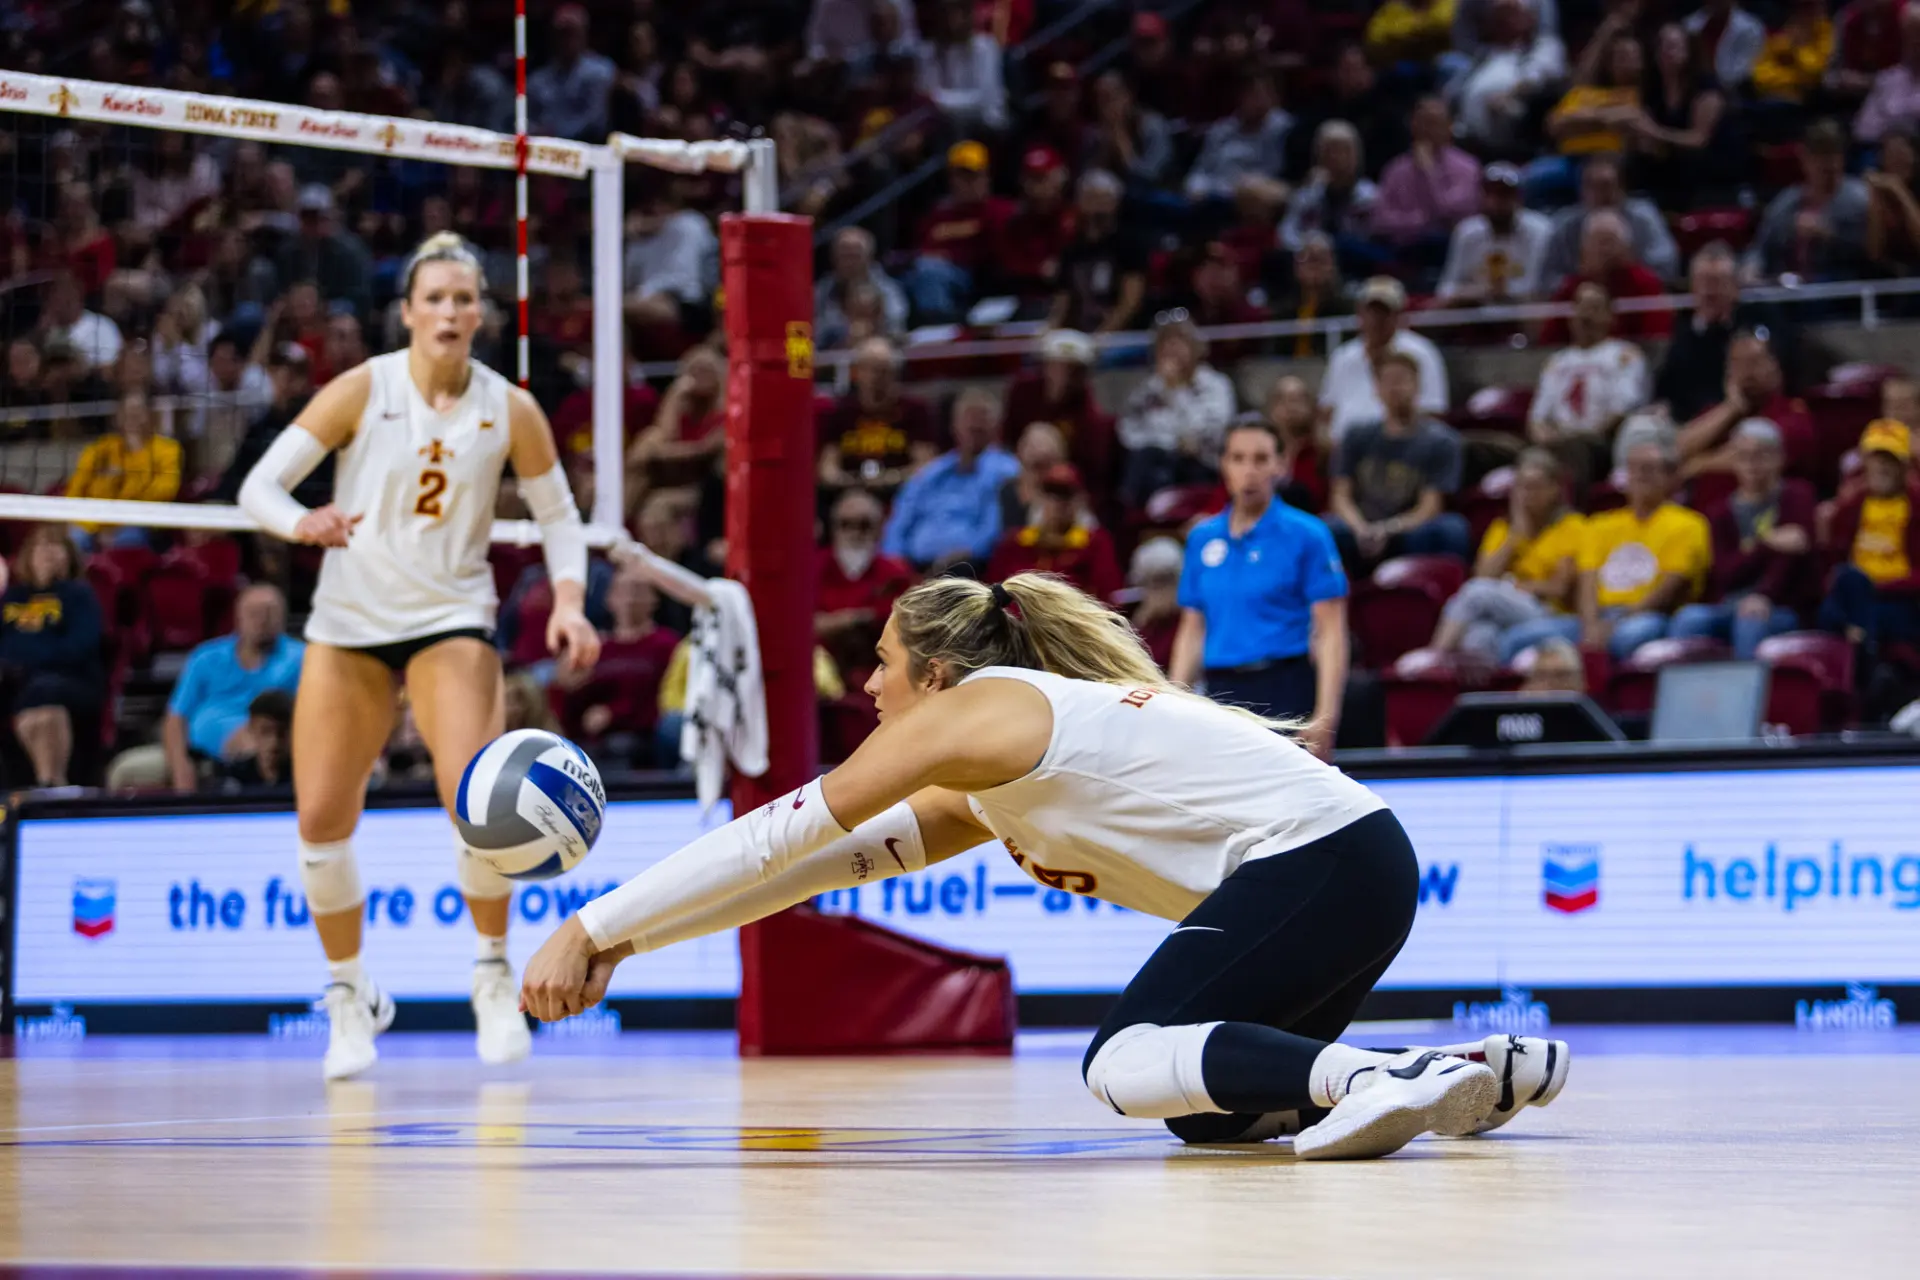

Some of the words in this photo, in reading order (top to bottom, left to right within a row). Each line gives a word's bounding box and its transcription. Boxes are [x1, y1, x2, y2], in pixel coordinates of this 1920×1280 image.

[184, 100, 225, 125] IOWA
[229, 107, 280, 129] STATE
[414, 468, 447, 519] 2
[562, 759, 607, 810] molte
[1683, 840, 1920, 912] helping
[169, 879, 247, 930] the
[265, 875, 415, 929] fure
